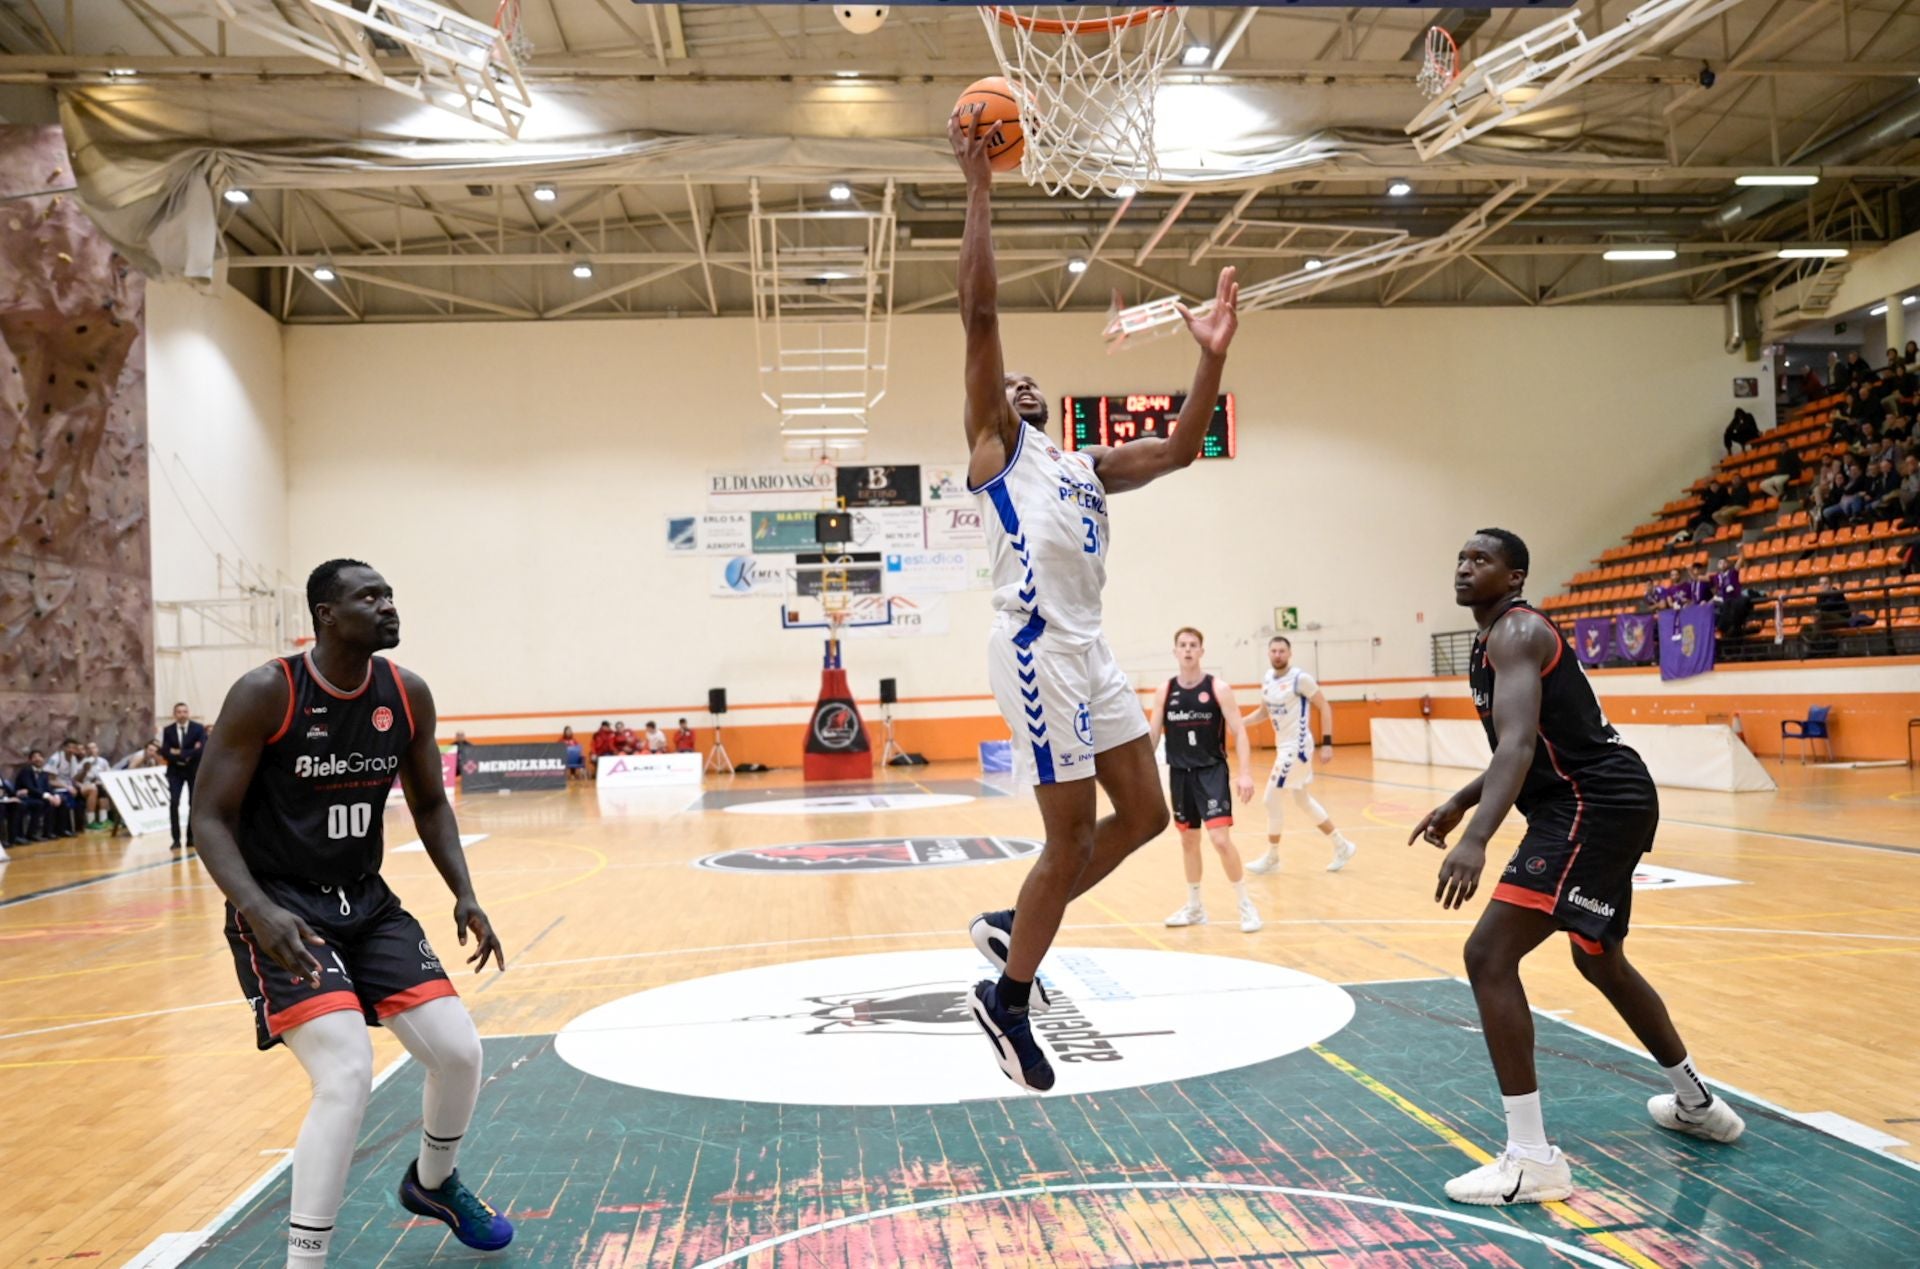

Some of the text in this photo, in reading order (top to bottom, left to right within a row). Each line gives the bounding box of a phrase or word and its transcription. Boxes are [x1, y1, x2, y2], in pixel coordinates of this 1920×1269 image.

[1126, 395, 1170, 411] 02:44
[1113, 421, 1136, 438] 47
[712, 473, 831, 491] EL DIARIO VASCO
[703, 516, 727, 524] ERLO
[1081, 516, 1100, 555] 3
[478, 758, 566, 773] MENDIZABAL
[328, 802, 372, 839] 00
